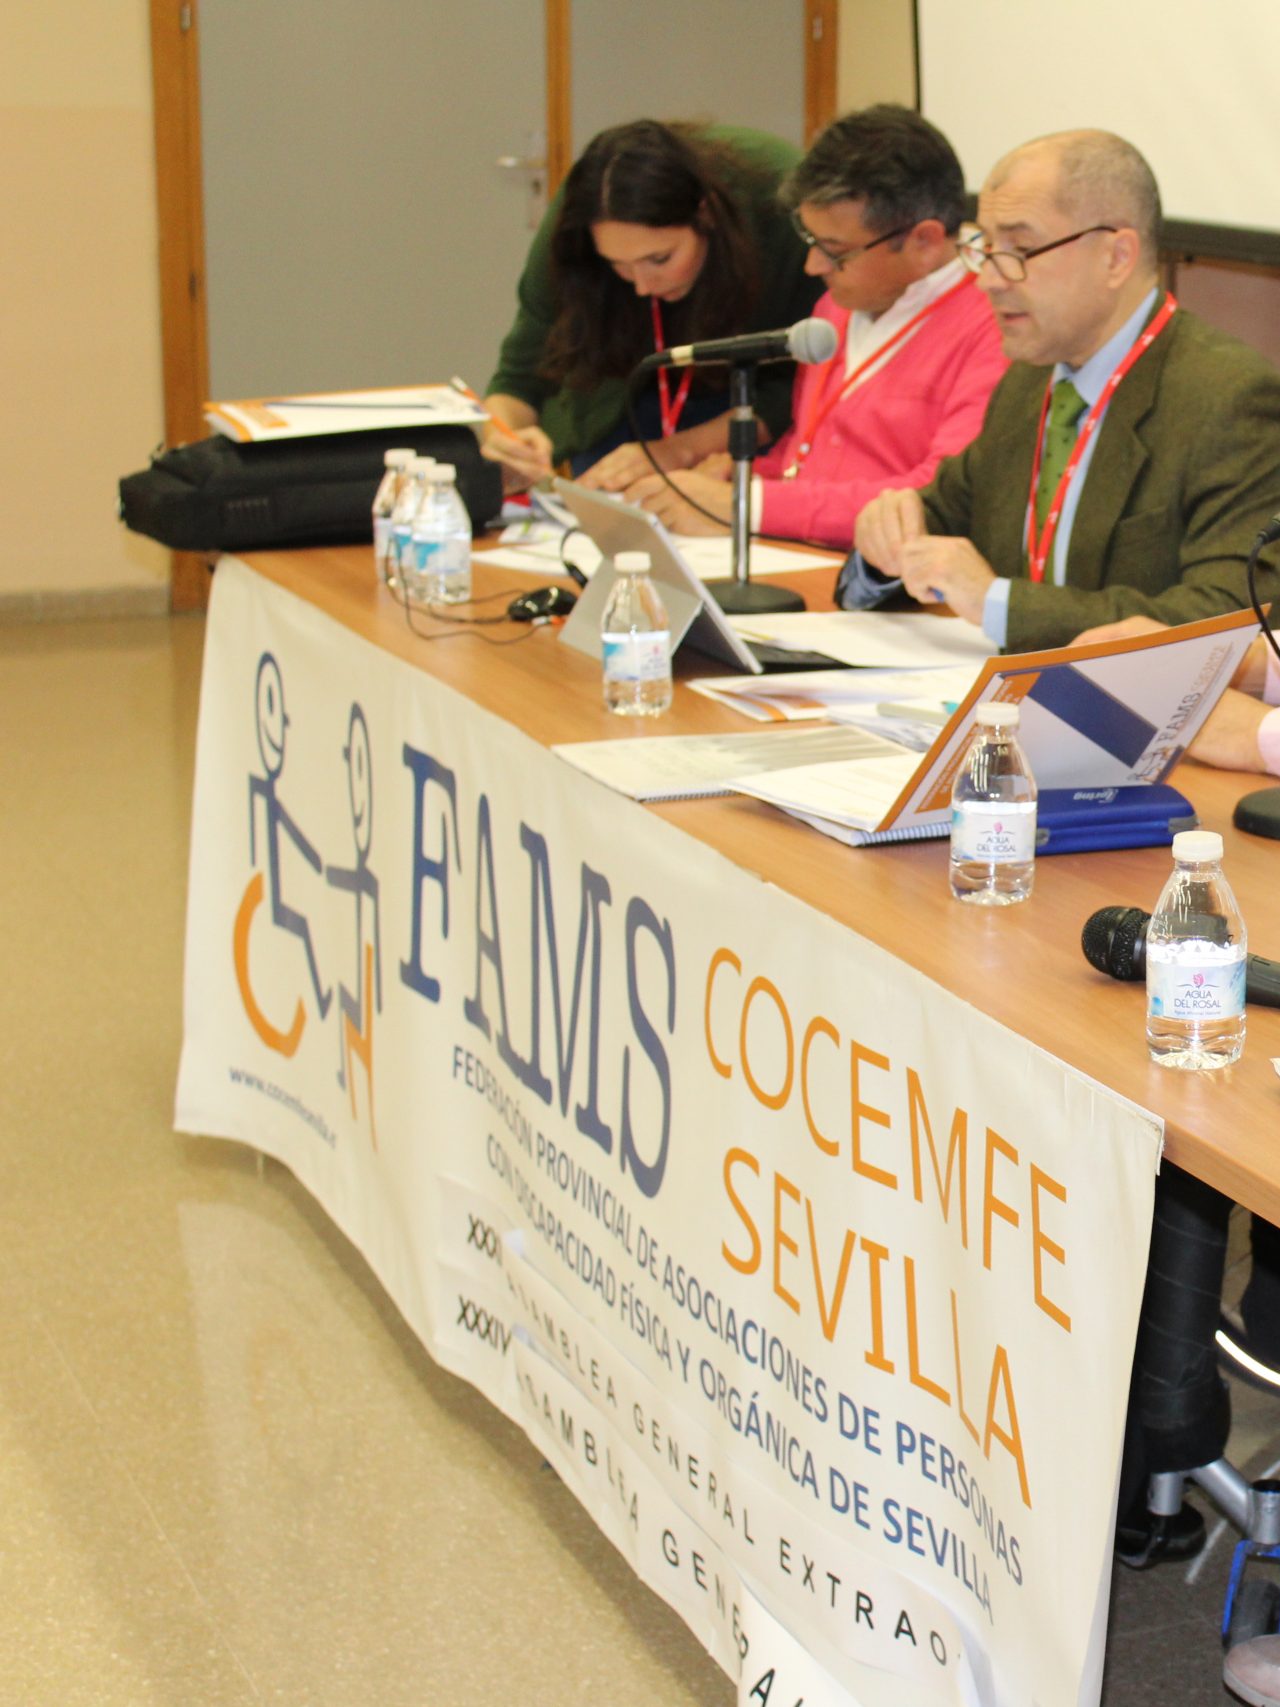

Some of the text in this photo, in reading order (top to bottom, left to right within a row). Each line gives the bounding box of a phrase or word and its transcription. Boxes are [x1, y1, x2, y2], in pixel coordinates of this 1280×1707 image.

[399, 741, 678, 1198] FAMS
[704, 947, 1072, 1334] COCEMFE
[1173, 998, 1222, 1009] DEL ROSAL
[1184, 990, 1213, 999] AGUA
[453, 1045, 533, 1159] FEDERACIÓN
[536, 1131, 633, 1255] PROVINCIAL
[636, 1225, 659, 1281] DE
[662, 1253, 829, 1423] ASOCIACIONES
[837, 1391, 882, 1456] DE
[896, 1420, 1023, 1587] PERSONAS
[456, 1293, 513, 1357] XXXIV
[513, 1362, 640, 1532] AMBLEA
[620, 1281, 673, 1371] FÍSICA
[677, 1338, 691, 1384] Y
[700, 1357, 820, 1500] ORGÁNICA
[828, 1465, 871, 1531] DE
[882, 1497, 994, 1627] SEVILLA
[633, 1402, 755, 1546] GENERAL
[721, 1146, 1033, 1511] SEVILLA
